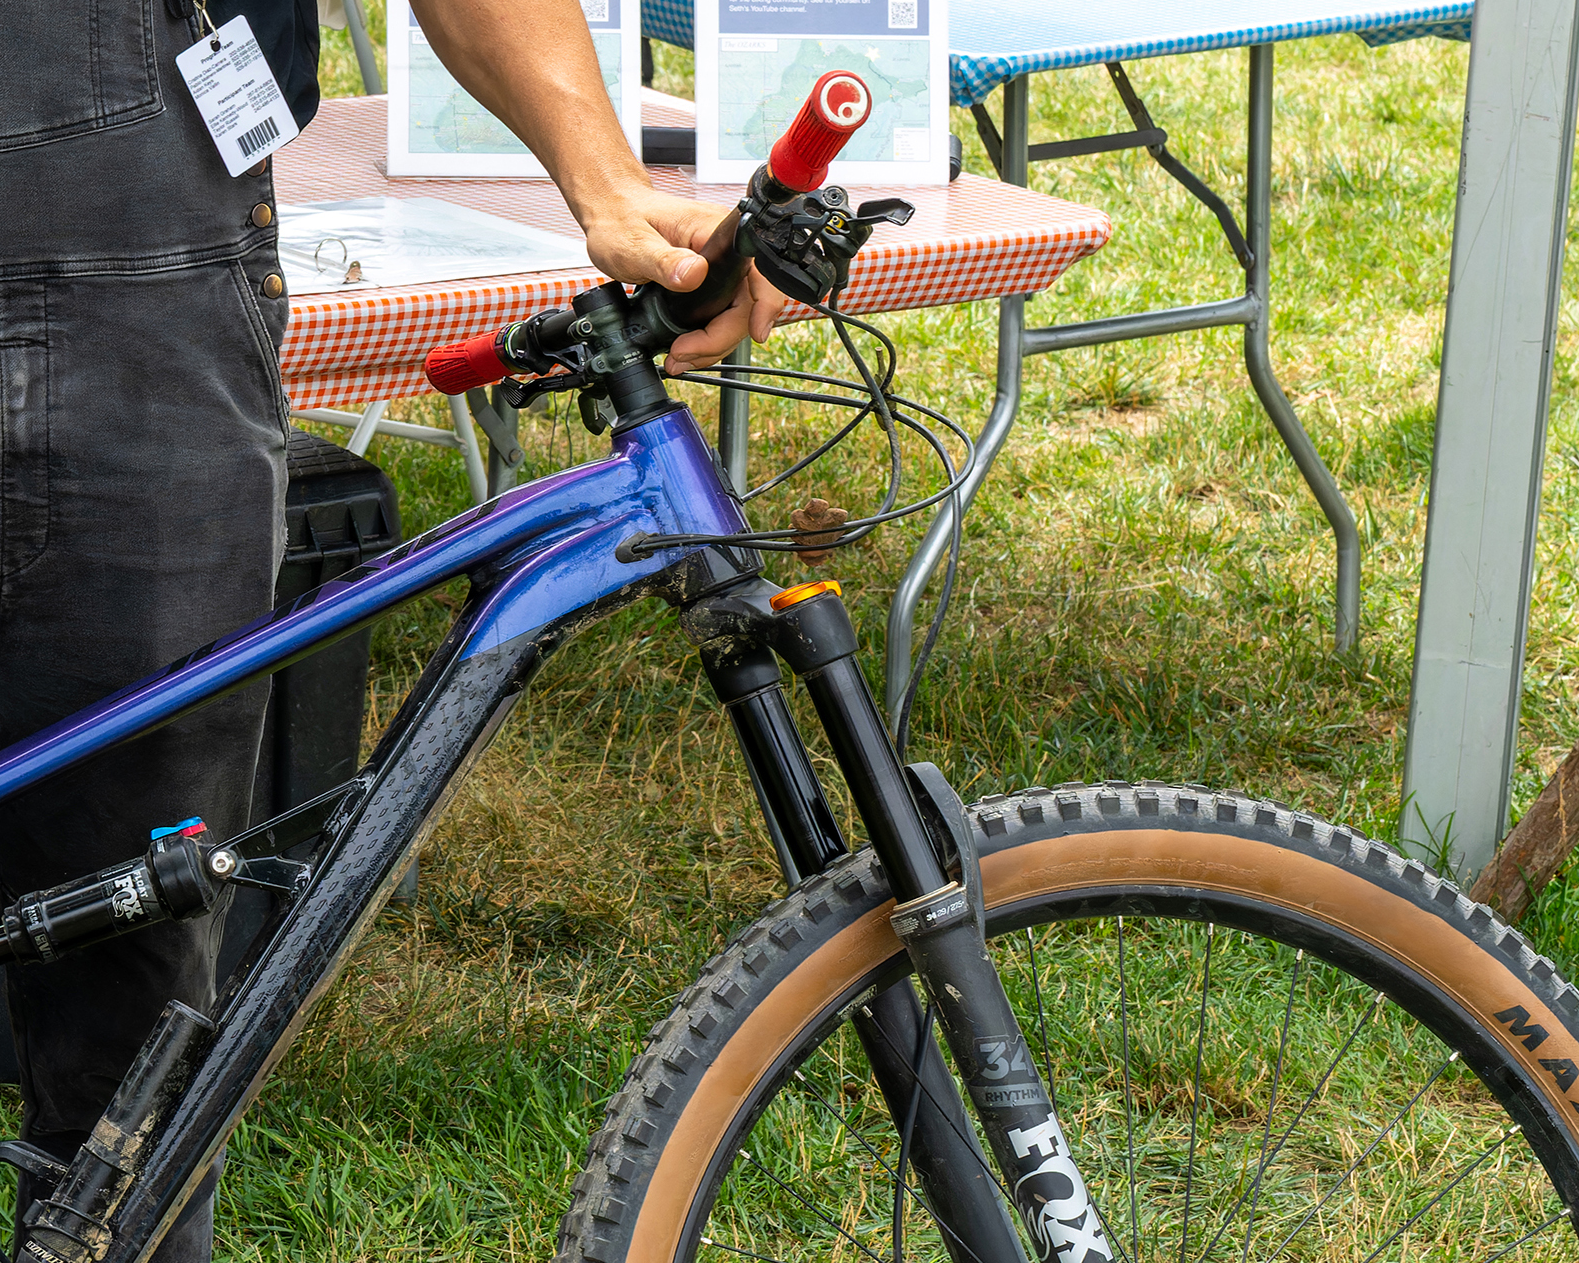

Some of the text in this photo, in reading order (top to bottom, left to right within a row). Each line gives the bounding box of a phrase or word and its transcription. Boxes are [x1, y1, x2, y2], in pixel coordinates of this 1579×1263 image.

[221, 42, 234, 51] Team
[217, 89, 243, 106] Participant
[242, 80, 255, 89] Team
[112, 875, 145, 919] FOX
[133, 870, 149, 898] FLOAT
[979, 1041, 1036, 1081] 34
[1493, 1005, 1579, 1115] MA
[985, 1088, 1040, 1103] RHYTHM
[1008, 1112, 1114, 1263] FOX
